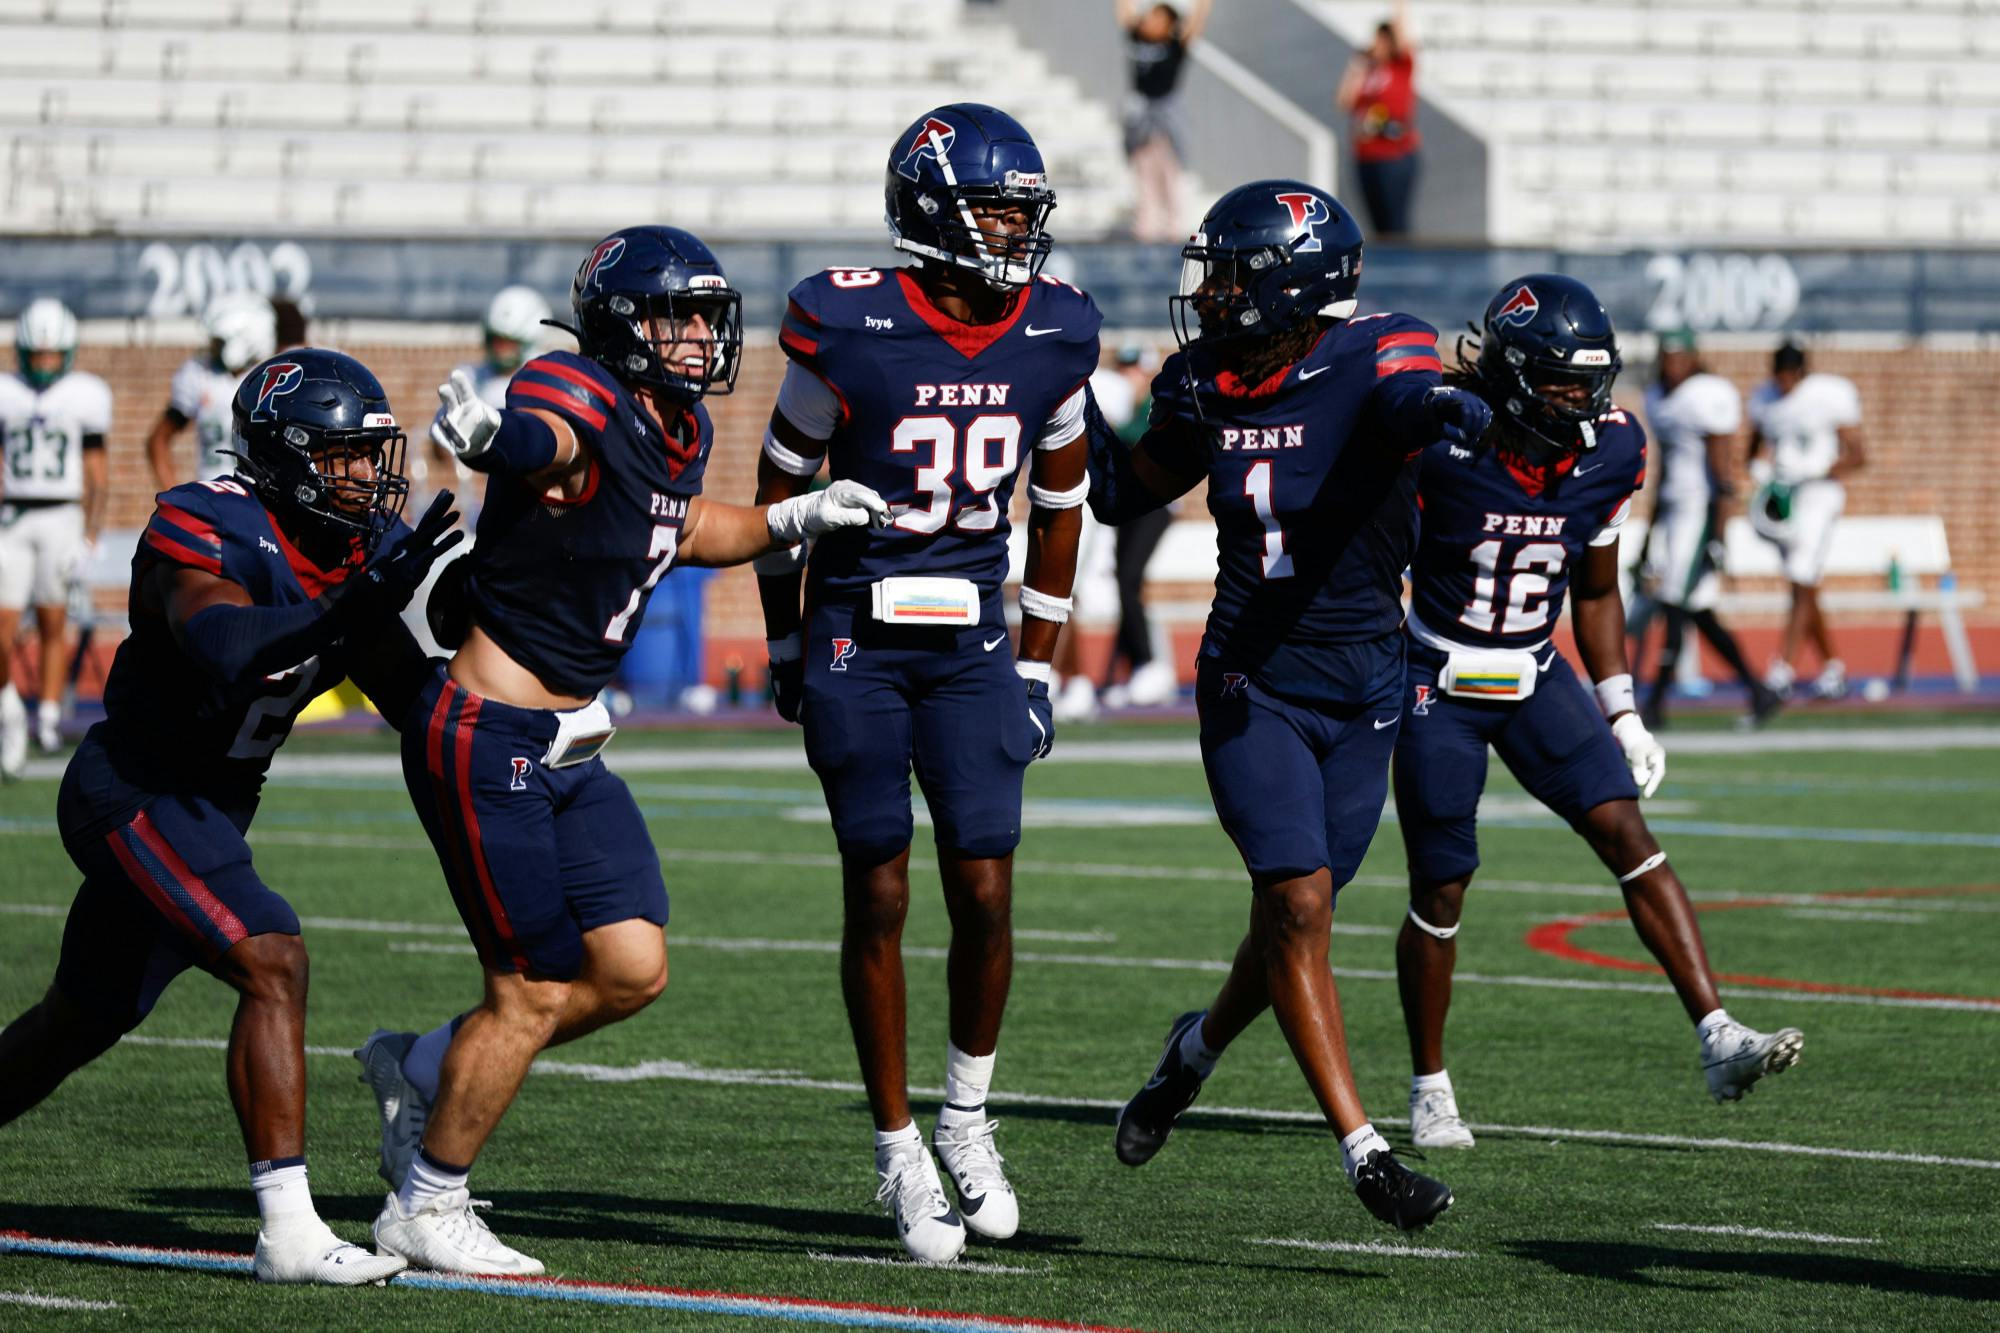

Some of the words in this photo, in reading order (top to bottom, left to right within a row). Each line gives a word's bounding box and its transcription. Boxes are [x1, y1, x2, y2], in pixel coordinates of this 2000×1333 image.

[1275, 192, 1329, 253] P
[581, 237, 625, 293] P
[1645, 253, 1798, 331] 2009
[1490, 285, 1539, 333] P
[251, 363, 303, 422] P
[914, 384, 1011, 406] PENN
[10, 425, 67, 479] 23
[1222, 425, 1305, 450] PENN
[890, 413, 1023, 535] 39
[650, 493, 688, 519] PENN
[1244, 459, 1295, 579] 1
[1482, 513, 1566, 536] PENN
[603, 524, 680, 642] 7
[1458, 539, 1567, 634] 12
[830, 638, 856, 671] P
[227, 655, 320, 759] 2
[1413, 685, 1437, 715] P
[511, 757, 532, 790] P
